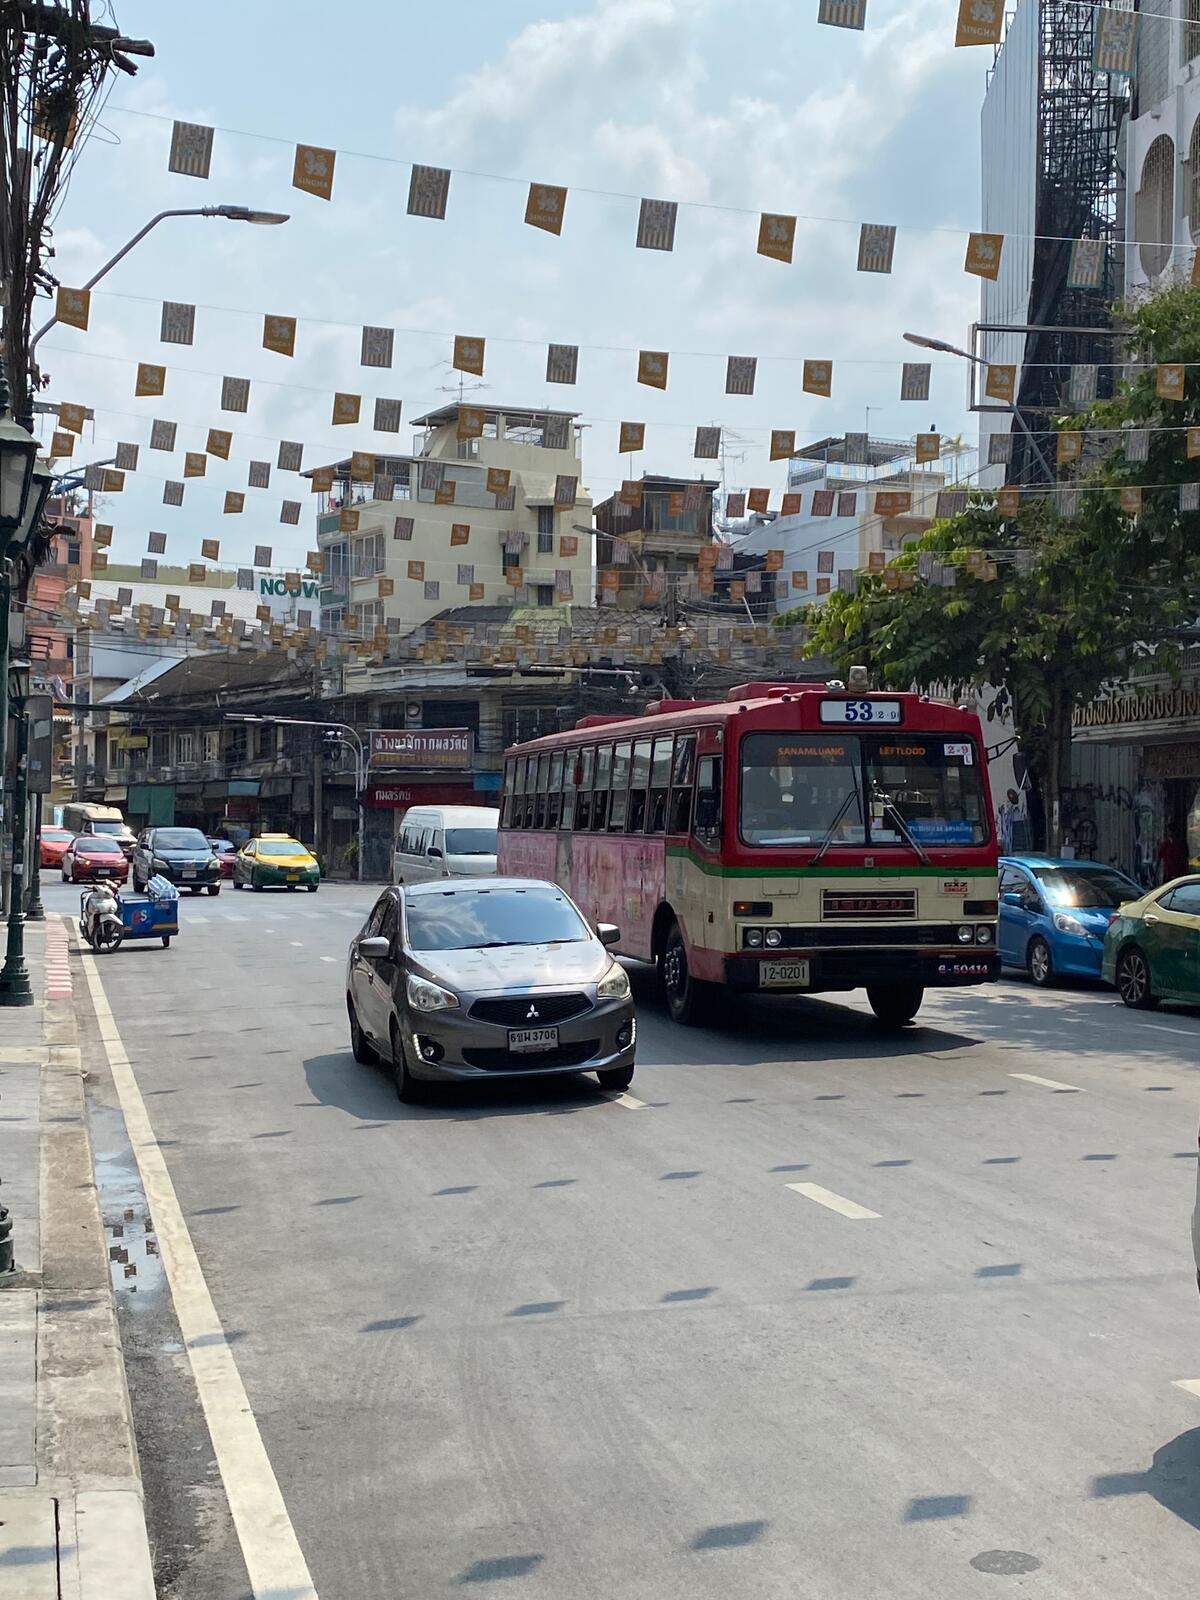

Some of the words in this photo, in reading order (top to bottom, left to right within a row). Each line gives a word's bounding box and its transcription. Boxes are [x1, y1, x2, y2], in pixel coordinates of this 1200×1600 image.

[845, 701, 873, 721] 53
[763, 966, 806, 980] 12-0201
[532, 1030, 556, 1041] 3706
